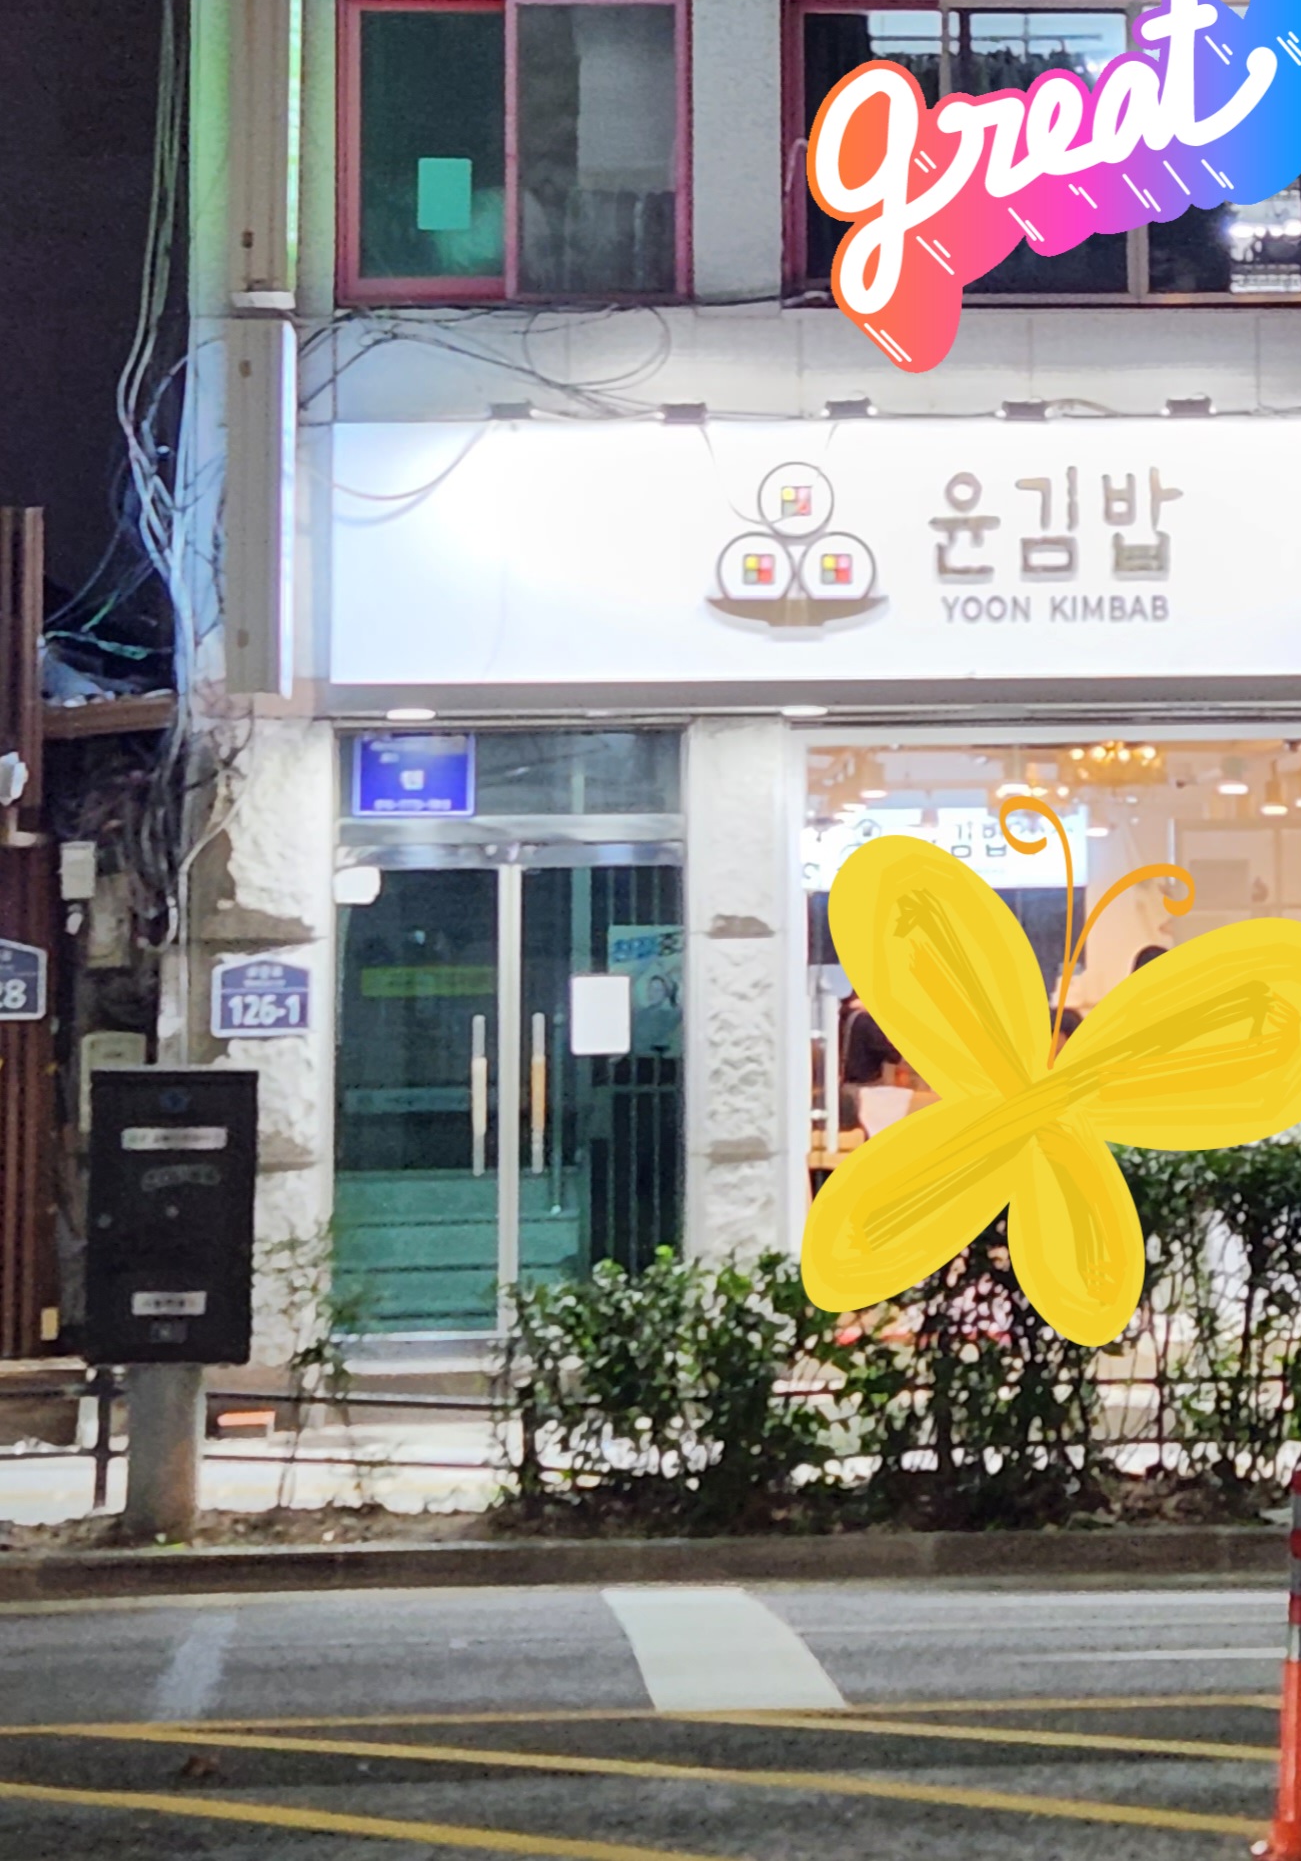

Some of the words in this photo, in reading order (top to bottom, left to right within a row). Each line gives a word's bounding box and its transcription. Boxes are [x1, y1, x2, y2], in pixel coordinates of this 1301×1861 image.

[928, 465, 1184, 585] 윤김밥
[941, 595, 1031, 623] YOON
[1049, 595, 1169, 623] KIMBAB
[0, 979, 27, 1009] 8
[228, 994, 300, 1026] 126-1
